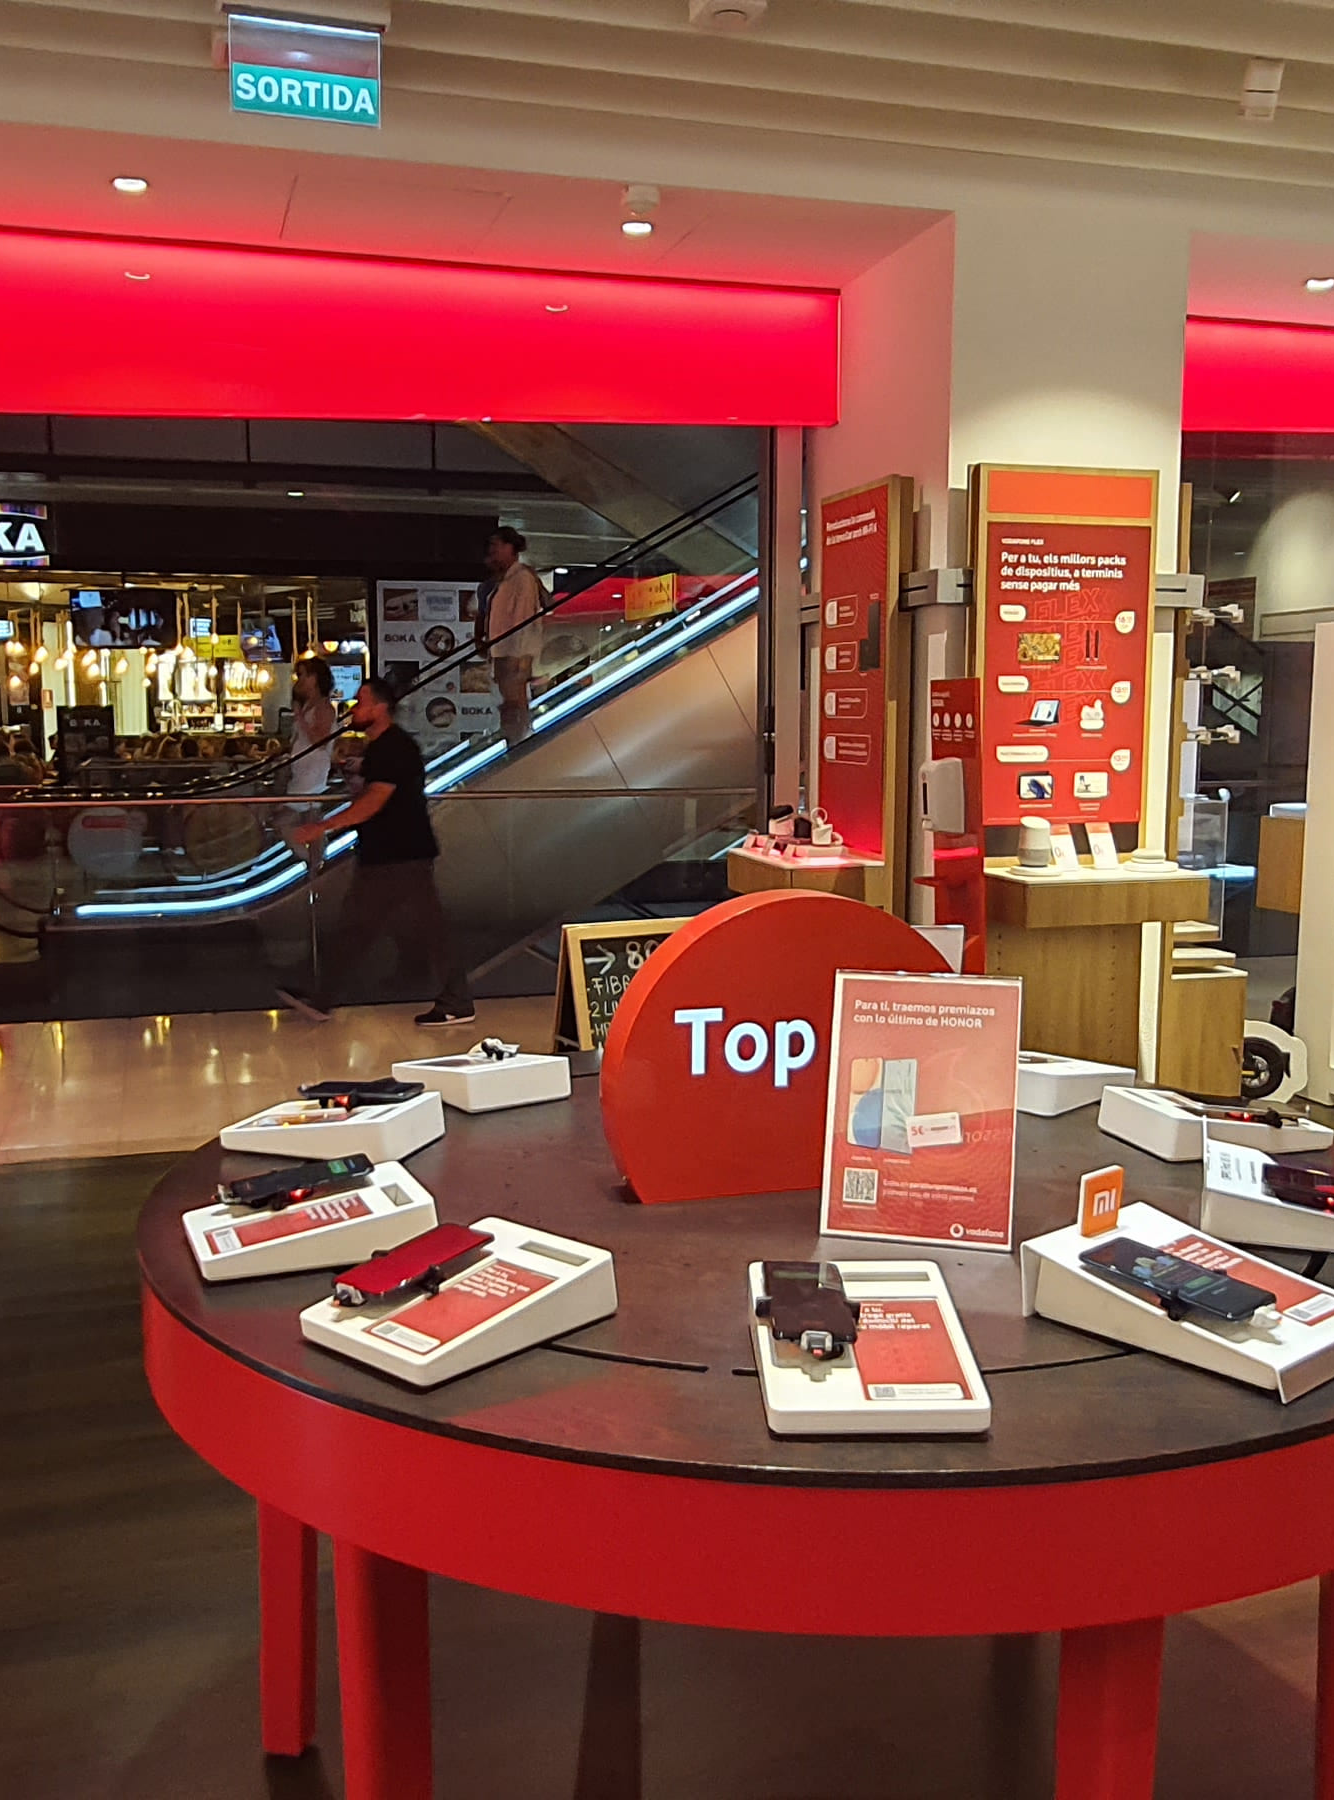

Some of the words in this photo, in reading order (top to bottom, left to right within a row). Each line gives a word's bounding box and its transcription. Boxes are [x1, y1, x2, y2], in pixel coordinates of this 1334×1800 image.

[236, 72, 376, 116] SORTIDA
[1000, 551, 1019, 564] Per
[1020, 554, 1026, 564] a
[1028, 553, 1042, 565] tu,
[1043, 553, 1059, 564] els
[1060, 553, 1097, 565] millors
[1097, 555, 1127, 567] packs
[1000, 565, 1014, 577] de
[1015, 566, 1073, 579] dispositius,
[1074, 568, 1080, 578] a
[1081, 568, 1124, 579] terminis
[1000, 580, 1029, 590] sense
[1030, 581, 1058, 593] pagar
[1059, 579, 1081, 591] més
[461, 706, 493, 716] BOKA
[590, 1001, 601, 1017] 2
[854, 999, 878, 1011] Para
[892, 1002, 937, 1014] traemos
[938, 1005, 996, 1017] premiazos
[853, 1014, 874, 1024] con
[875, 1014, 886, 1025] lo
[888, 1013, 924, 1026] último
[925, 1016, 939, 1027] de
[940, 1016, 983, 1029] HONOR
[674, 1007, 816, 1088] Top
[910, 1125, 926, 1136] 5€
[965, 1227, 1005, 1239] vodafone
